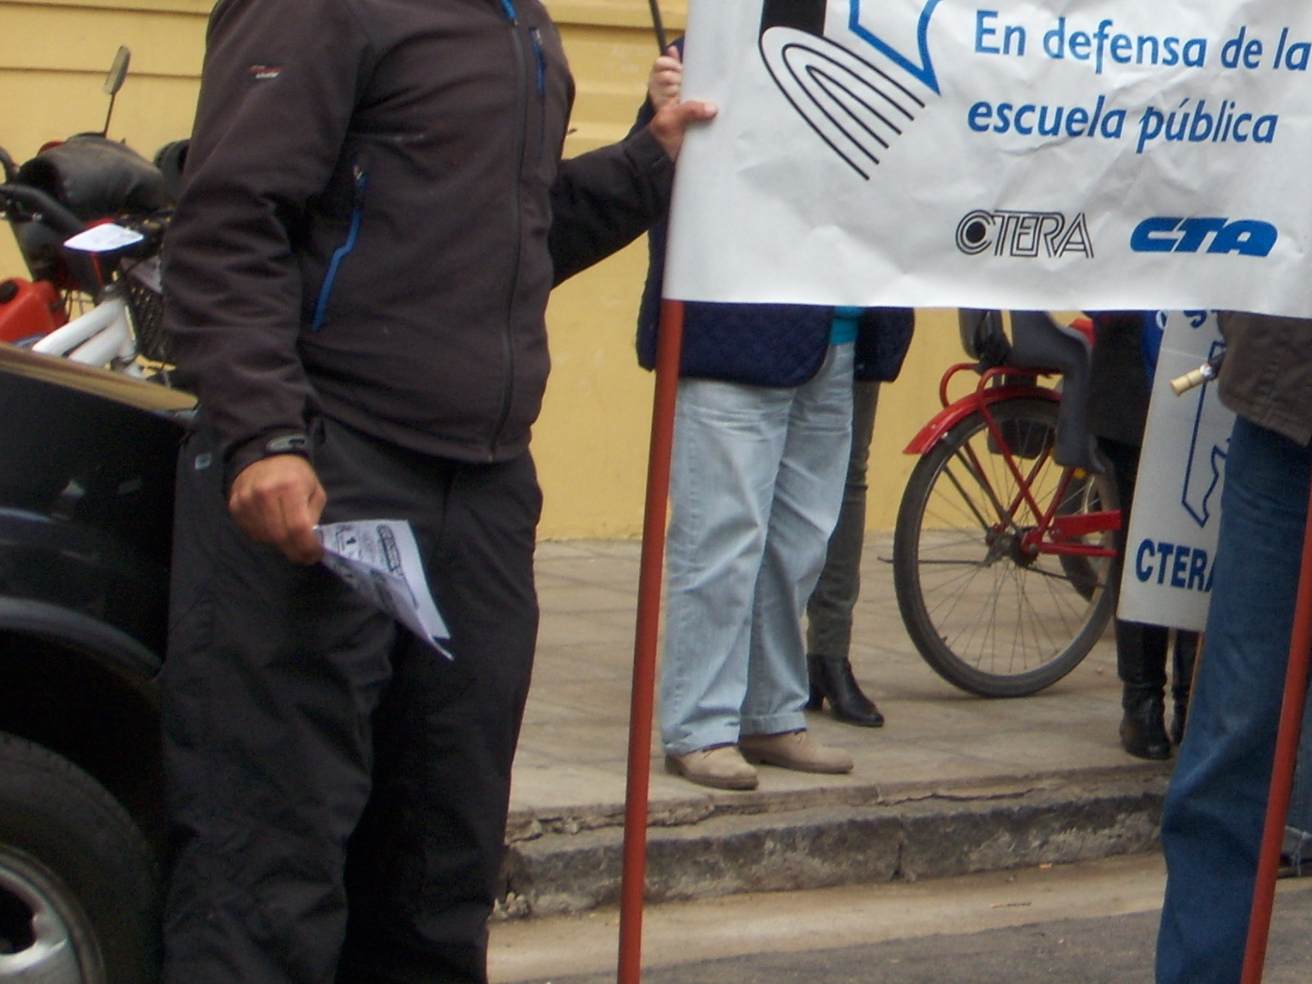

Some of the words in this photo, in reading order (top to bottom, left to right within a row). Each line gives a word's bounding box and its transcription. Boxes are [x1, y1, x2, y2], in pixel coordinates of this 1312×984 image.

[973, 8, 1027, 56] En
[1041, 16, 1208, 75] defensa
[1219, 26, 1262, 69] de
[1271, 28, 1312, 72] la
[966, 93, 1128, 140] escuela
[1135, 95, 1280, 154] pública
[955, 209, 1095, 260] CTERA
[1129, 216, 1279, 259] CTA
